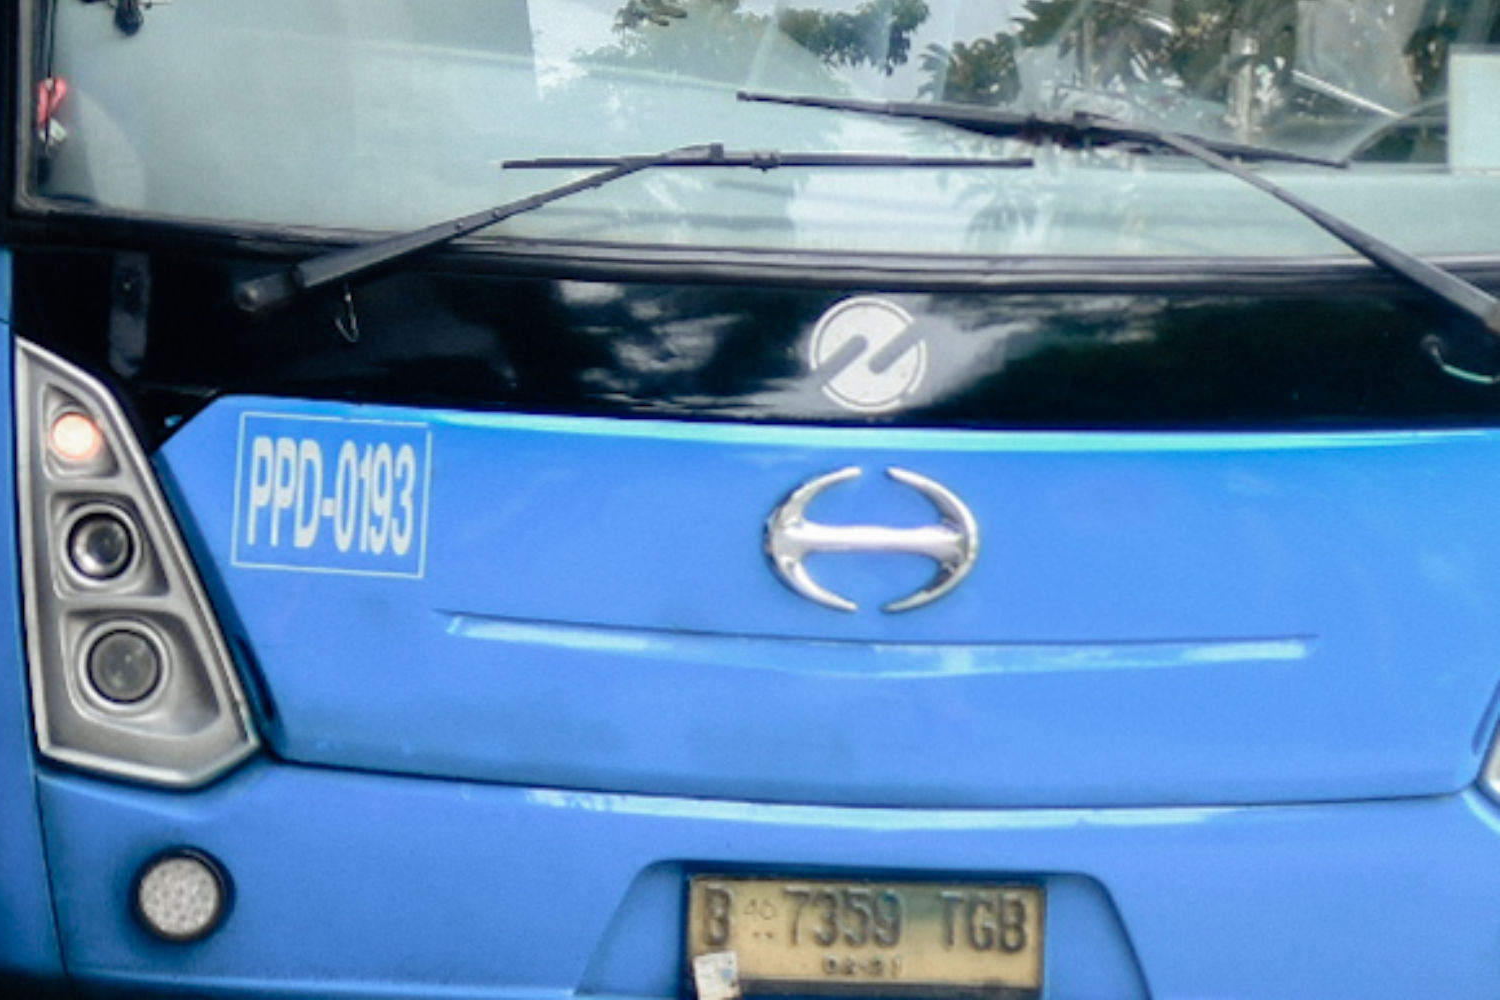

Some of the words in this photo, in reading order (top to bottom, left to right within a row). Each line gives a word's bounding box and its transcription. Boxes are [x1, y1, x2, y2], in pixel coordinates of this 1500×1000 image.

[247, 436, 417, 556] PPD-0193
[703, 883, 732, 947] B
[785, 886, 904, 949] 7359
[940, 890, 1029, 953] TGB
